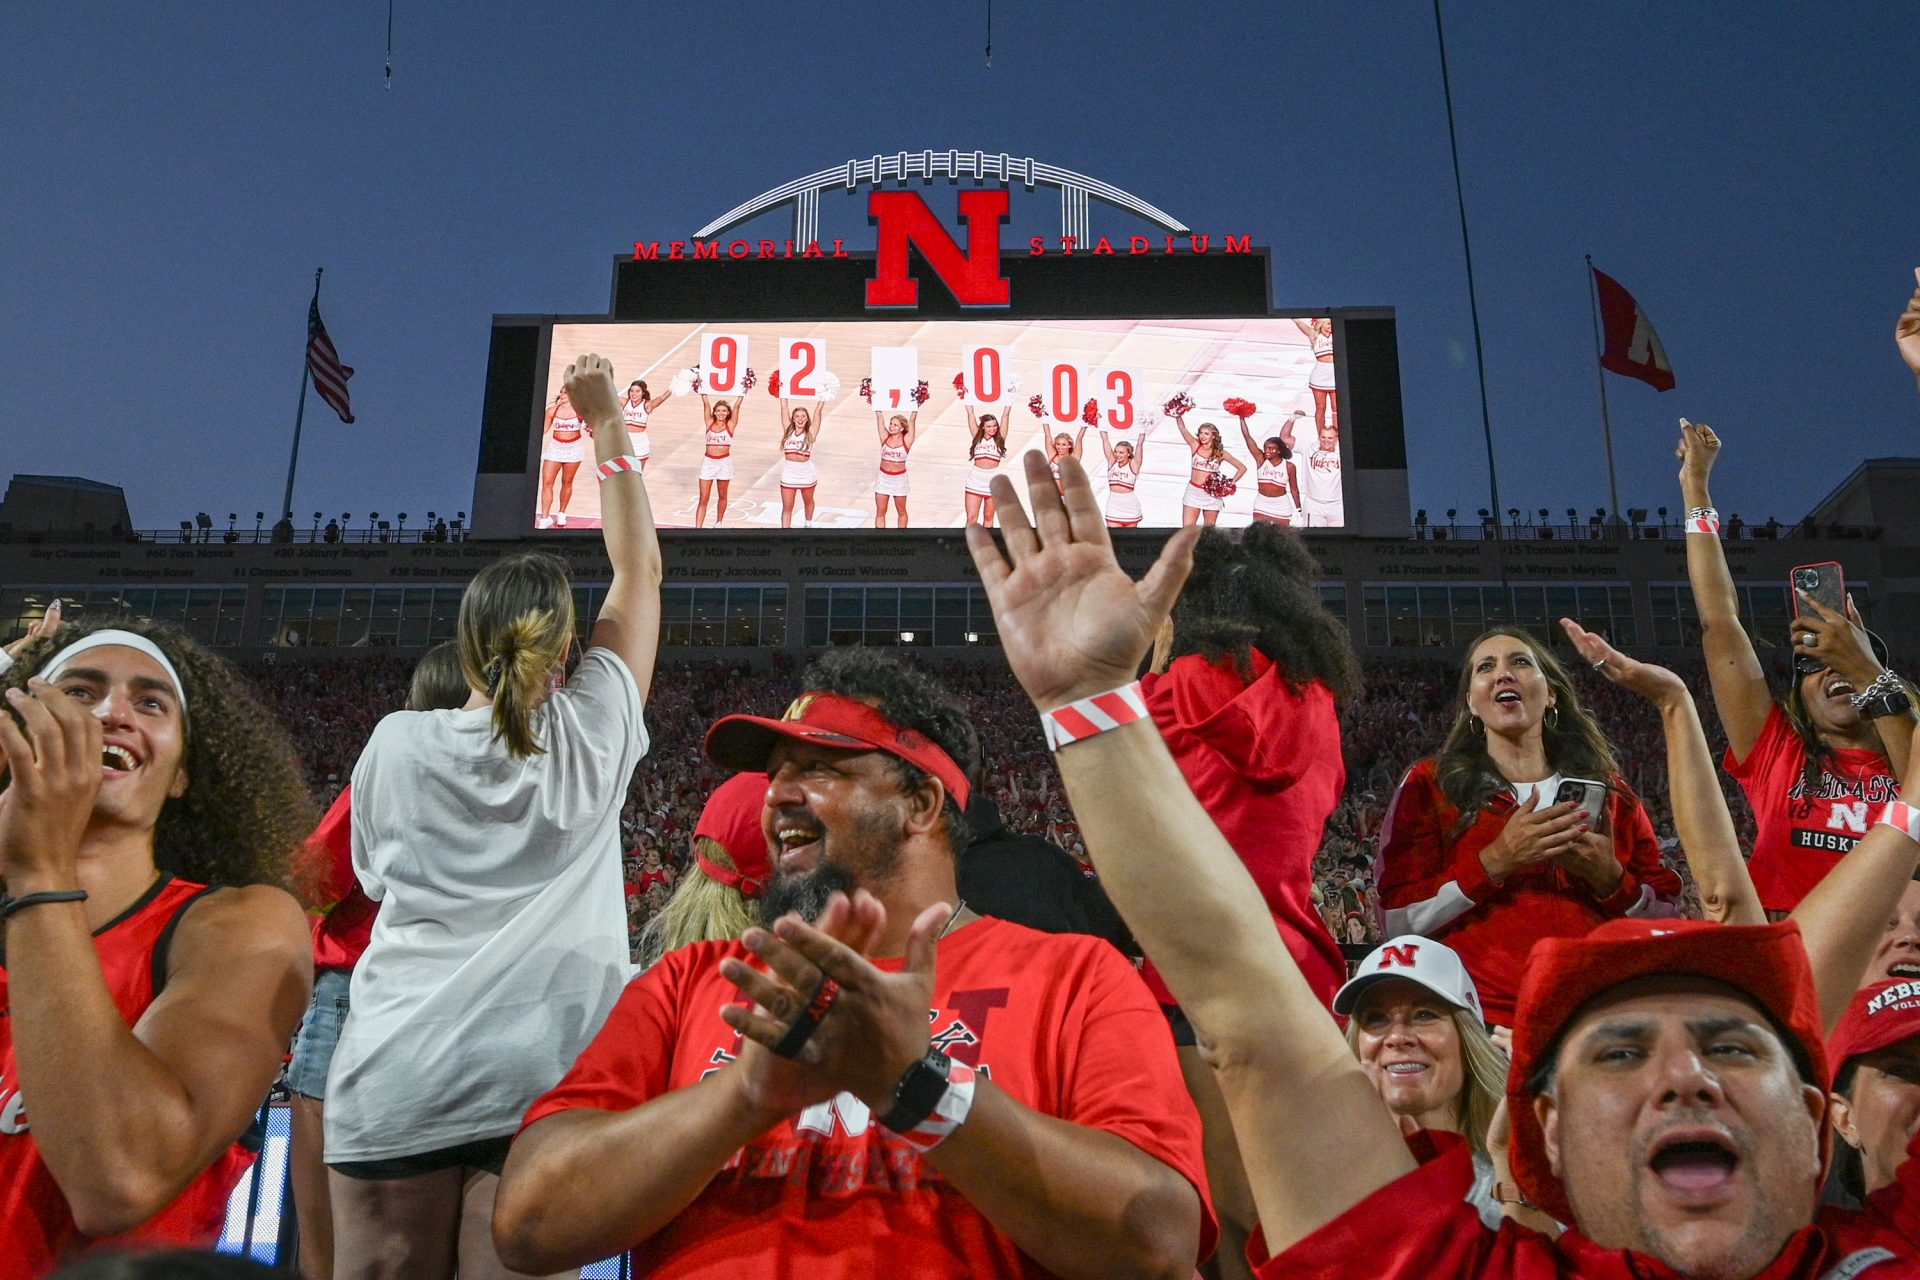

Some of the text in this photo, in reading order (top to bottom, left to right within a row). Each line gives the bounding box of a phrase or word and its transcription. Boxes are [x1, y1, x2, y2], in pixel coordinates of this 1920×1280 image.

[632, 234, 1253, 261] MEMORIAL STADIUM
[865, 190, 1010, 308] N
[30, 549, 52, 561] Guy
[145, 548, 234, 559] #60 Tom Novak
[273, 547, 388, 559] #20 Johnny Rodgers
[411, 547, 501, 558] #79 Rich Glover
[679, 547, 771, 557] #30 Mike Rozier
[791, 547, 916, 557] #71 Dean Steinkuhler
[1375, 545, 1480, 557] #72 Zach Wiegert
[1525, 545, 1576, 555] Tommie
[1579, 545, 1620, 555] Frazier
[99, 567, 194, 579] #25 George Sauer
[233, 567, 352, 578] #1 Clarence Swanson
[390, 567, 411, 577] #38
[412, 567, 438, 577] Sam
[667, 567, 782, 578] #75 Larry Jacobson
[798, 567, 908, 577] #98 Grant Wistrom
[1403, 565, 1443, 575] Forrest
[1446, 565, 1480, 575] Behm
[1525, 565, 1568, 576] Wayne
[780, 695, 817, 722] N
[1826, 801, 1869, 834] N
[1377, 943, 1420, 970] N
